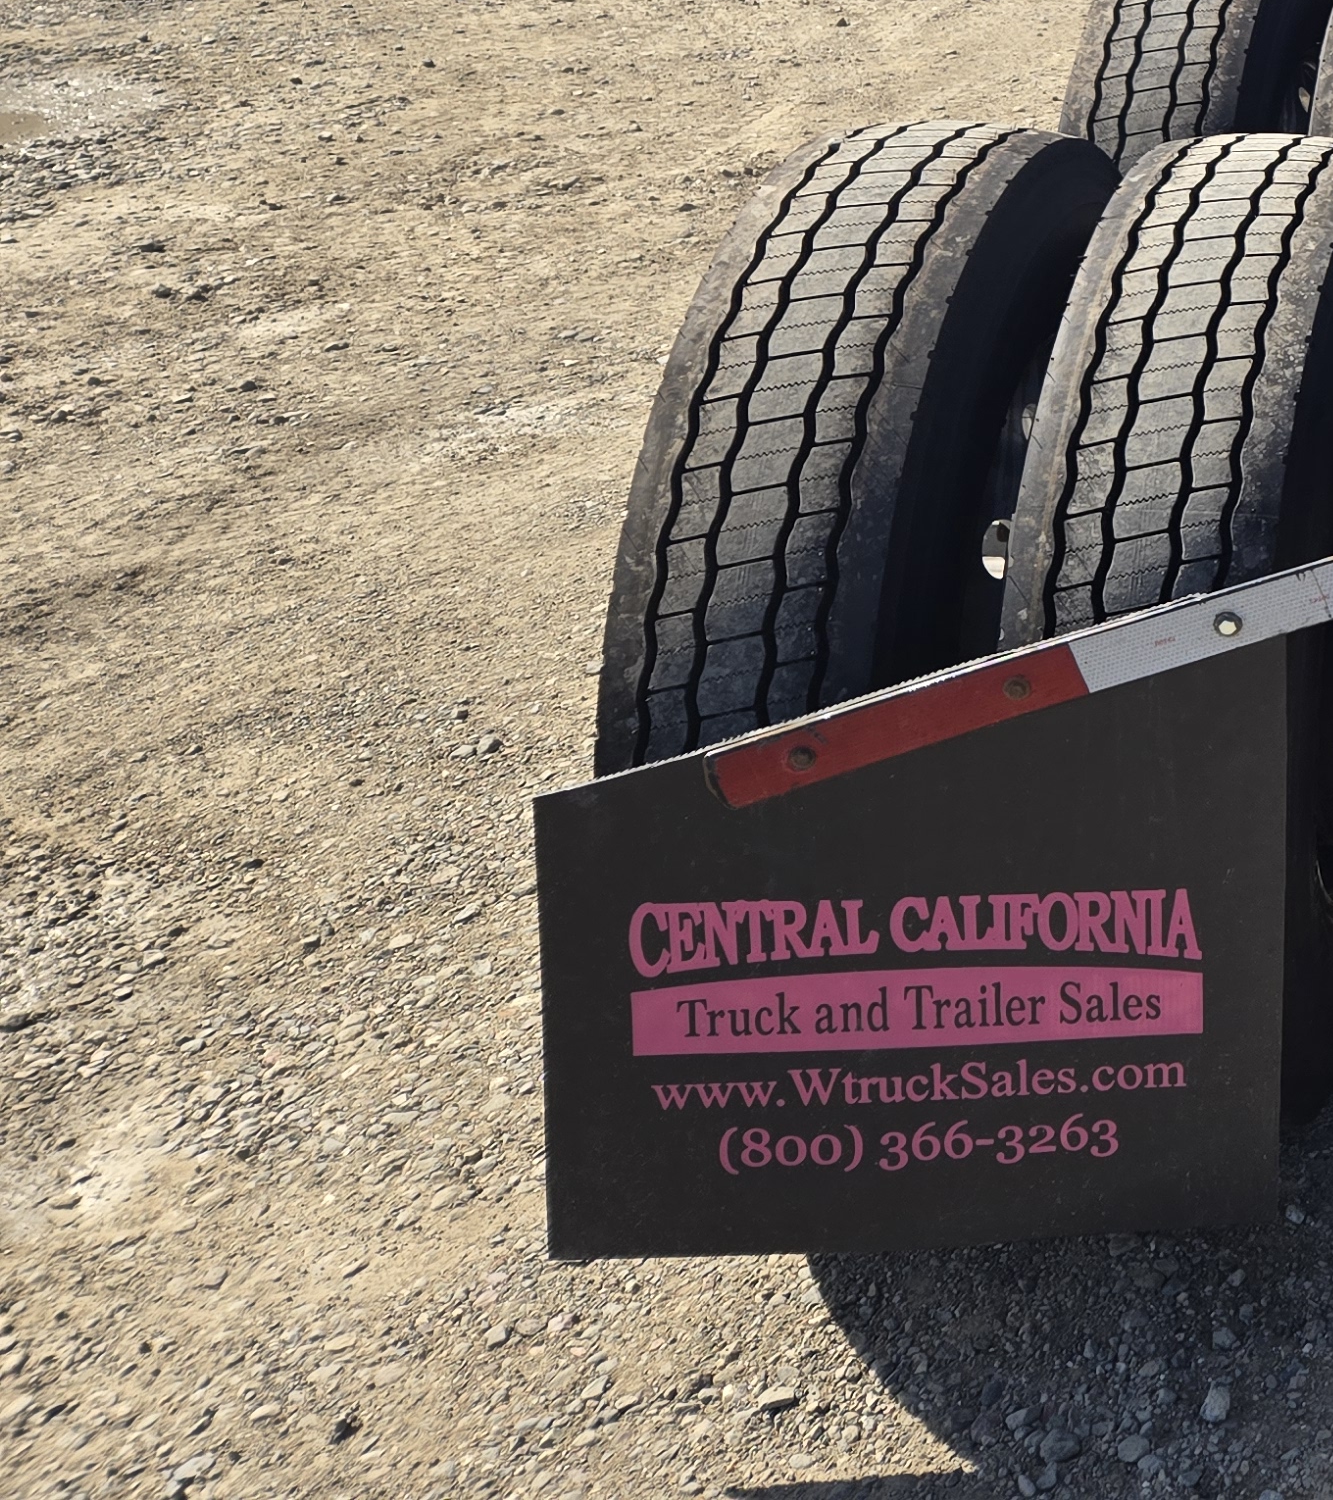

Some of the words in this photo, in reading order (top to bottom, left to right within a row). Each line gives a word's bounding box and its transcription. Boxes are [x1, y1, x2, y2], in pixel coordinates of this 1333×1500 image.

[628, 898, 880, 978] CENTRAL
[889, 888, 1203, 961] CALIFORNIA
[676, 992, 803, 1038] Truck
[814, 986, 890, 1034] and
[903, 981, 1046, 1031] Trailer
[1058, 980, 1162, 1025] Sales
[651, 1058, 1188, 1111] www.WtruckSales.com
[718, 1124, 864, 1175] (800)
[878, 1112, 1120, 1172] 366-3263
